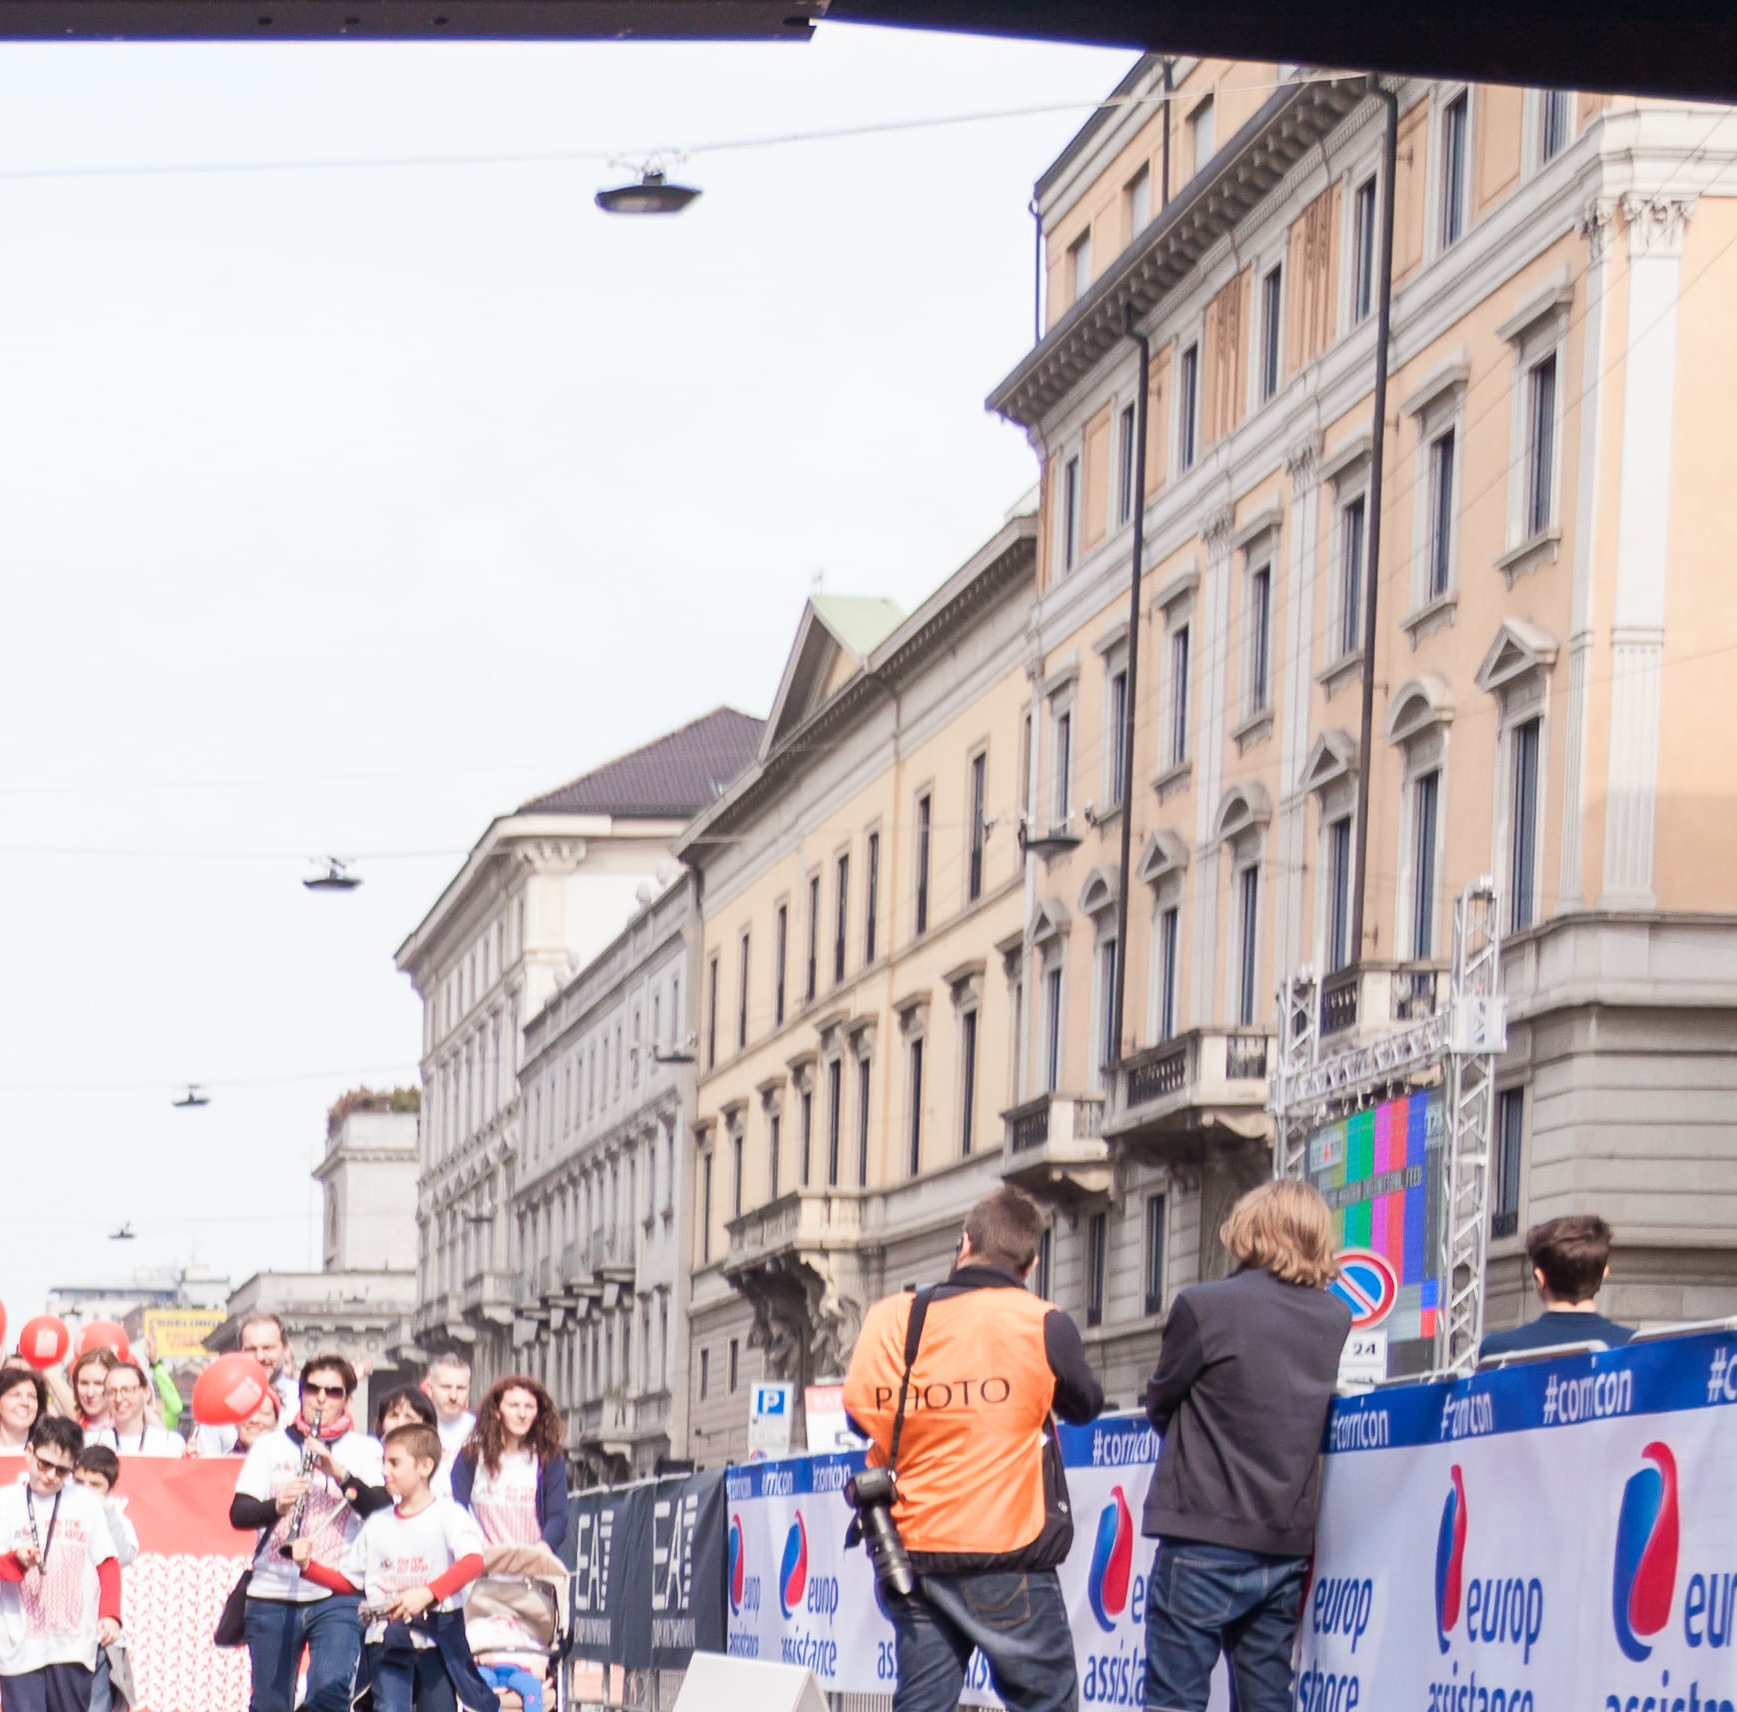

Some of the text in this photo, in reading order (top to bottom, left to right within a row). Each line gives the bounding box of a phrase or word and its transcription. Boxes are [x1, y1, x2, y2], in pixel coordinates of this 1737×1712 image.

[1352, 1342, 1377, 1356] 24
[763, 1391, 780, 1413] P
[876, 1377, 1010, 1413] PHOTO
[1313, 1576, 1373, 1654] europ
[1466, 1577, 1544, 1666] europ
